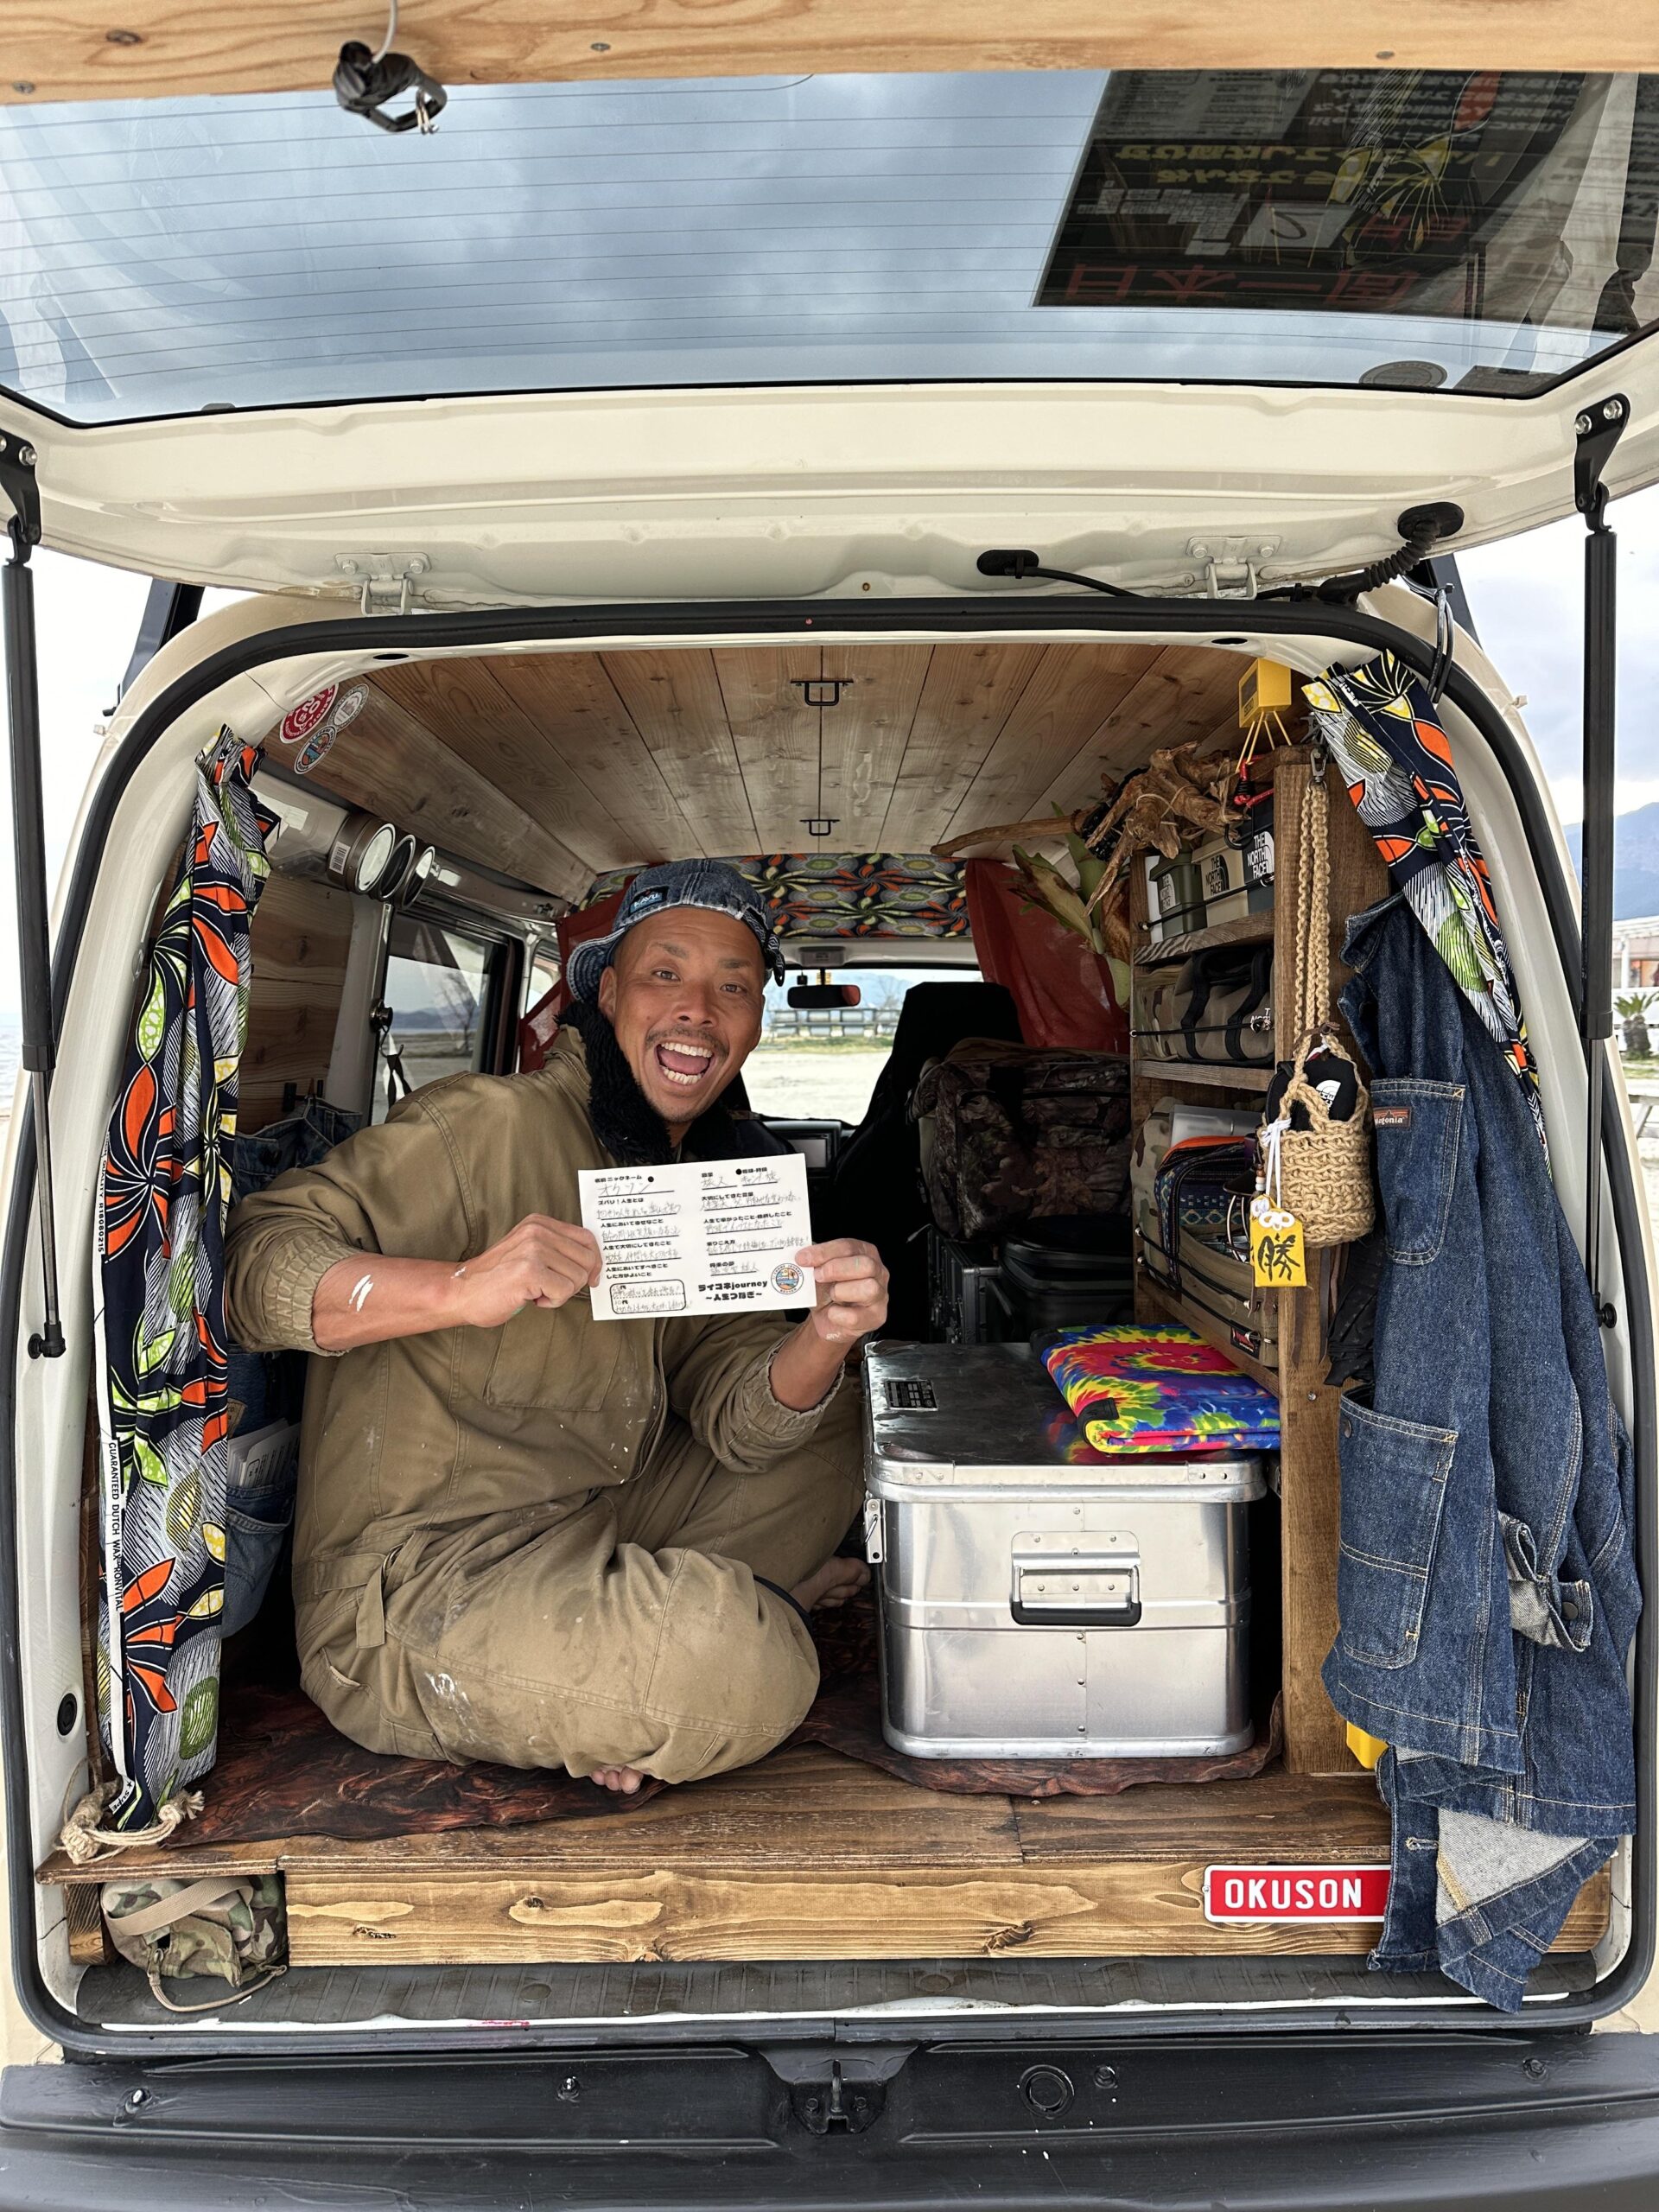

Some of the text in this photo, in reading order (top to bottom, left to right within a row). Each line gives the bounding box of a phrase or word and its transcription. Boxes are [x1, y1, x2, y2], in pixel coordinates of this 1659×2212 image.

[1254, 833, 1265, 846] THE
[1248, 847, 1267, 867] NORTH
[108, 1442, 119, 1500] GUARANTEED
[111, 1503, 120, 1535] DUTCH
[112, 1539, 121, 1560] WAX
[1224, 1878, 1362, 1910] OKUSON
